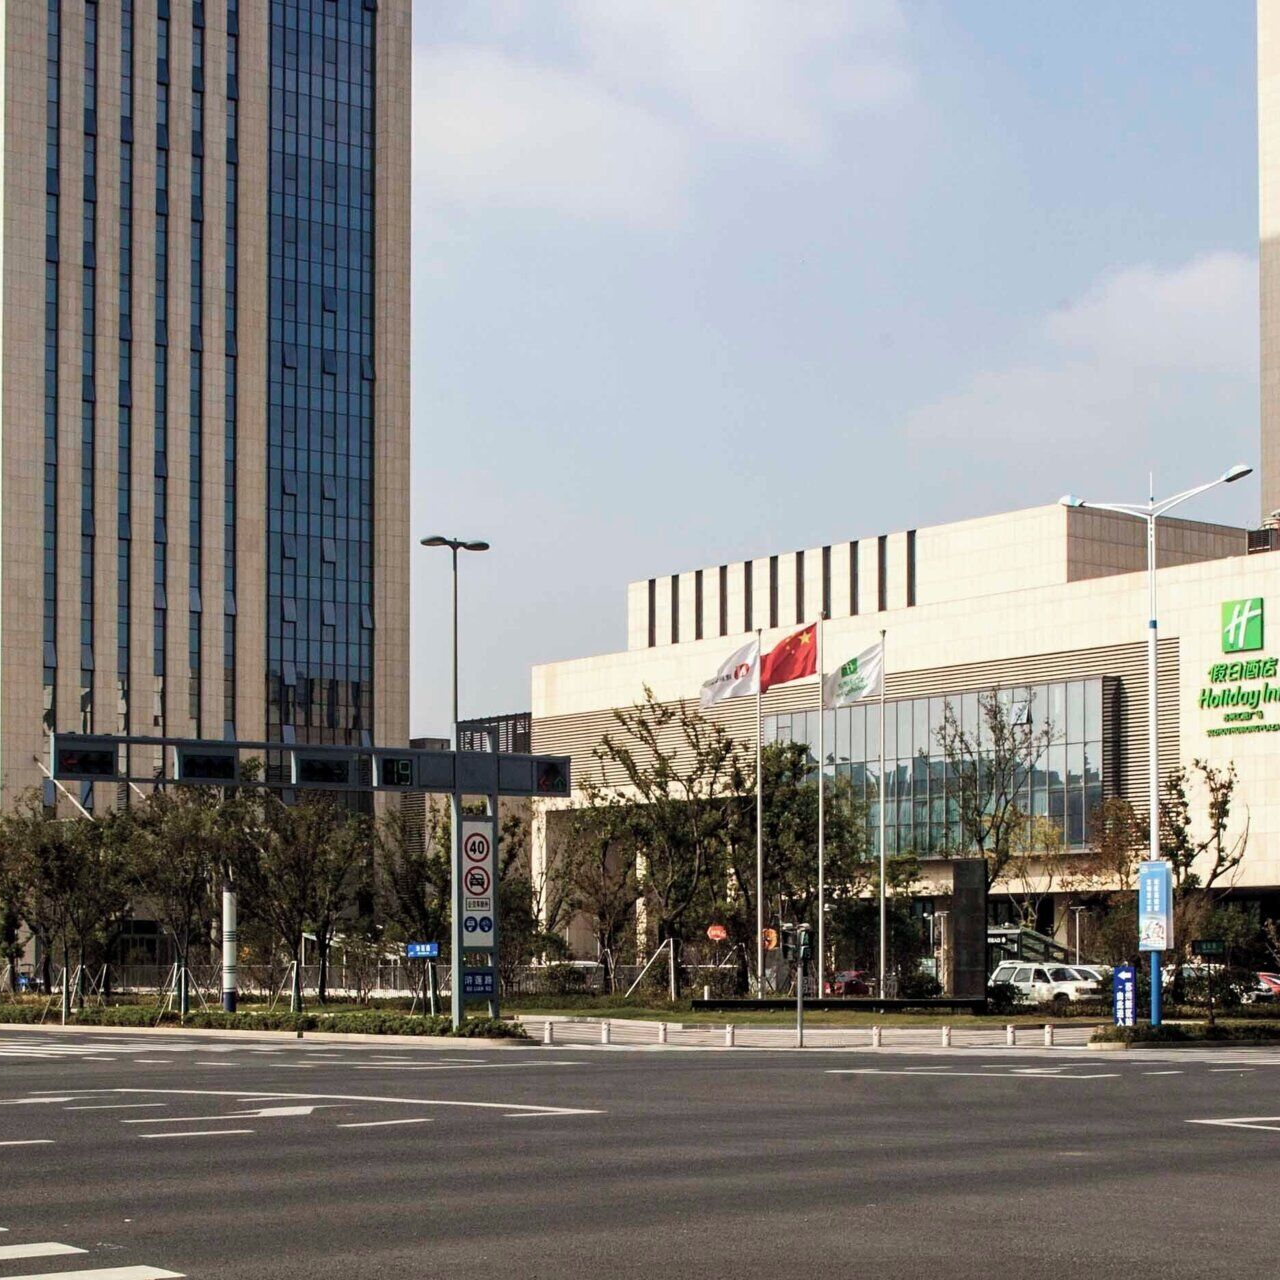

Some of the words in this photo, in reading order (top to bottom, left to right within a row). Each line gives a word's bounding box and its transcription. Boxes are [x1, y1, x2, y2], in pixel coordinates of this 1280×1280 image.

[1209, 657, 1279, 683] 假日酒店
[1198, 685, 1261, 710] Holiday
[469, 840, 484, 855] 40
